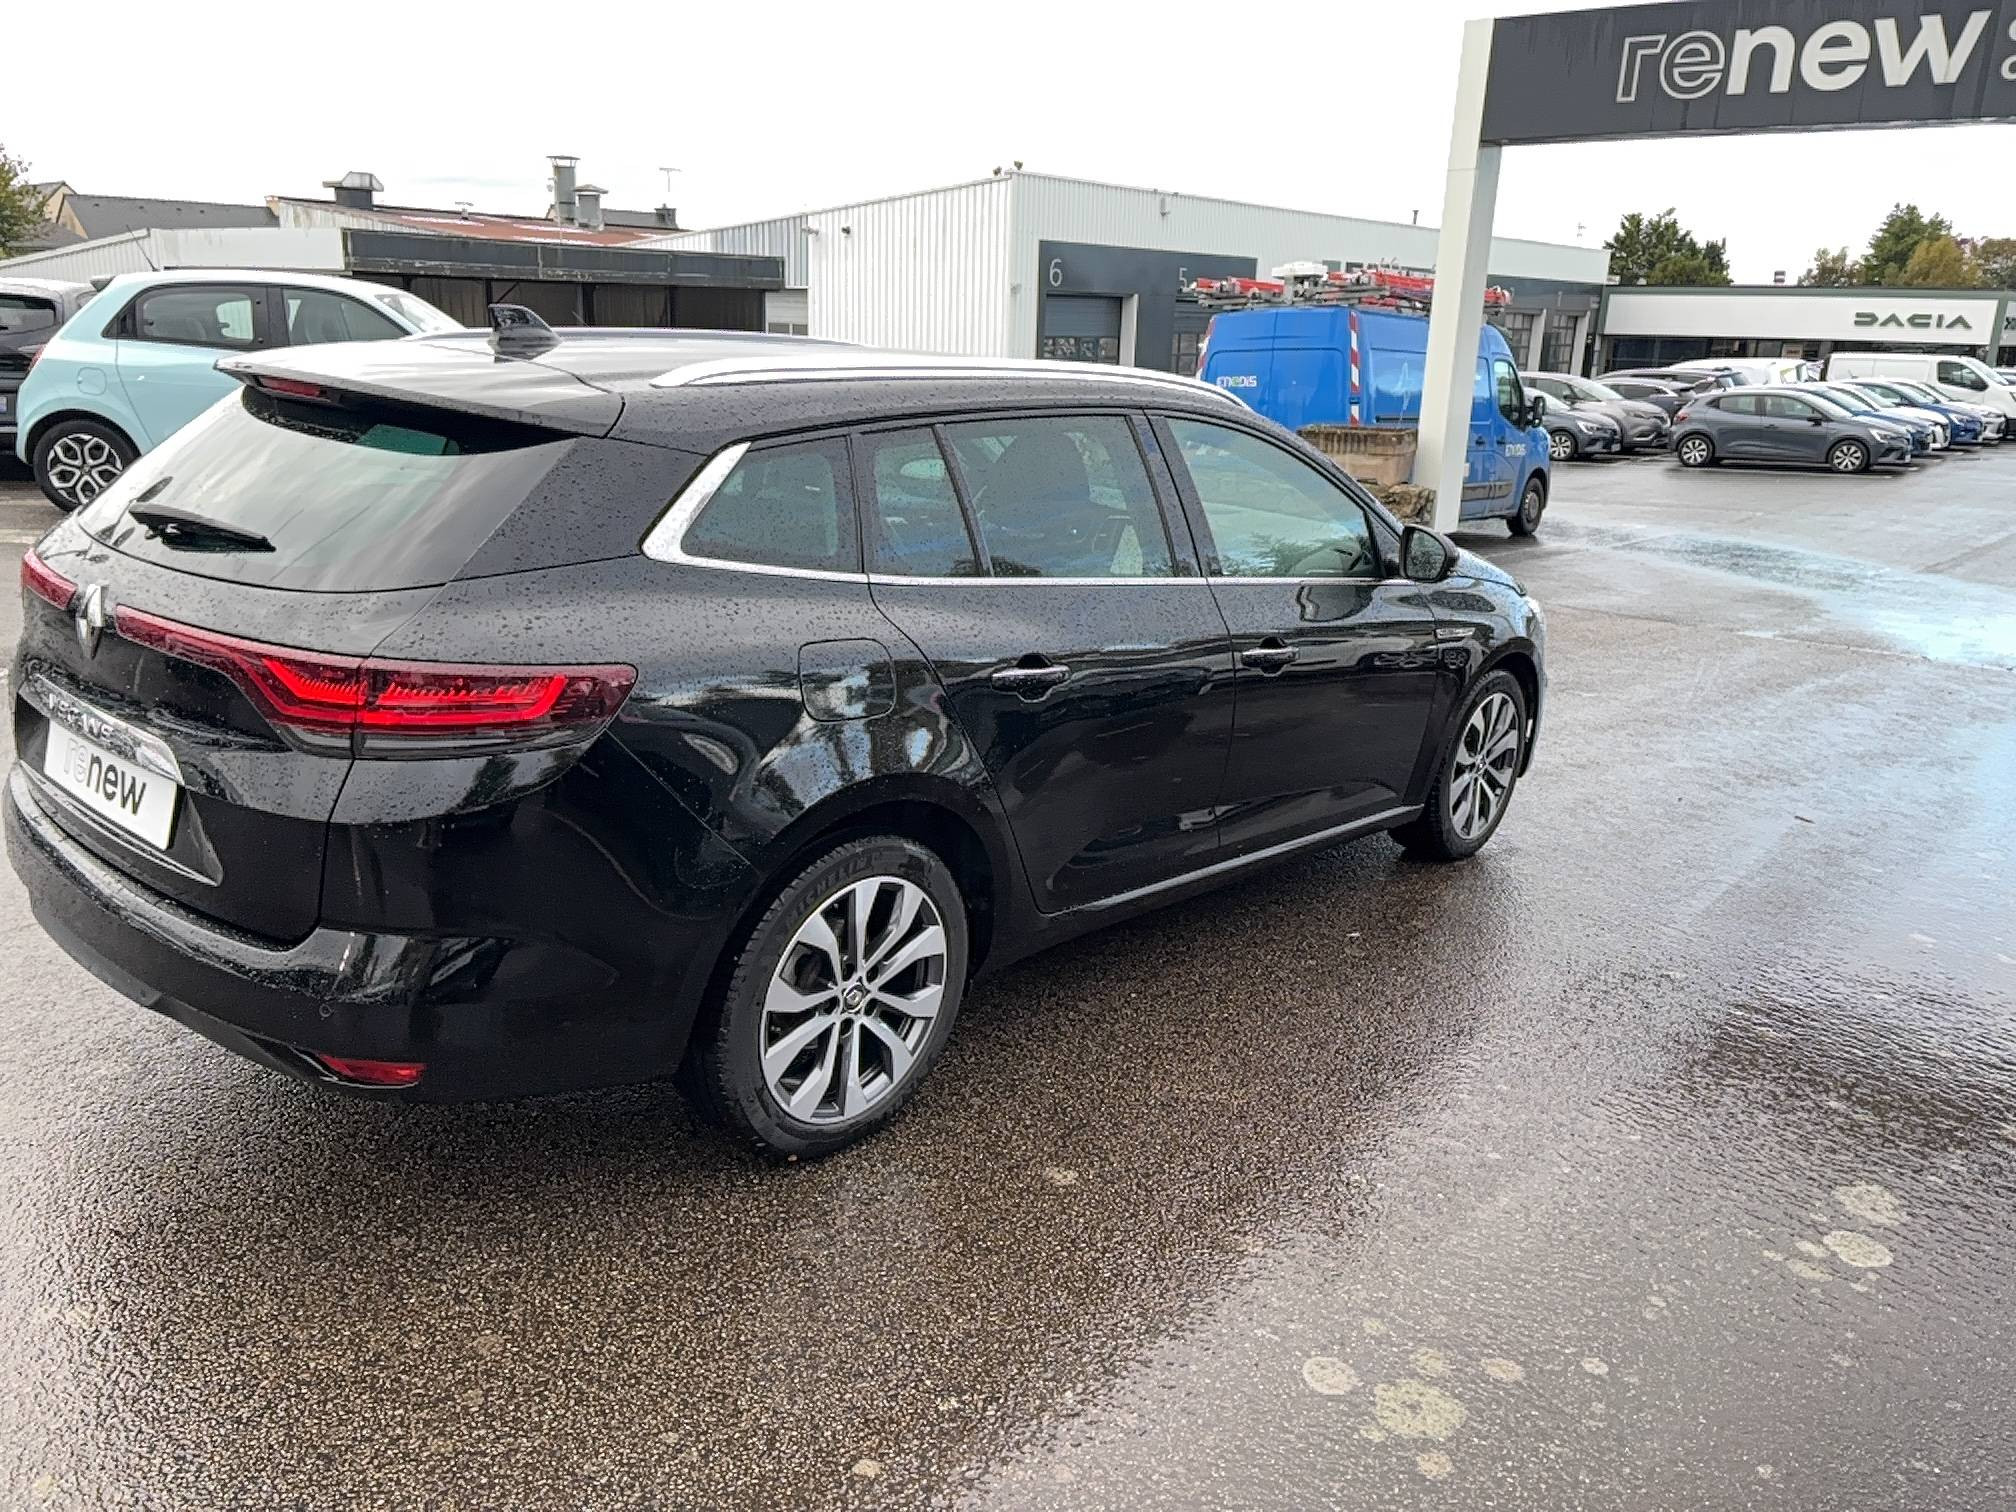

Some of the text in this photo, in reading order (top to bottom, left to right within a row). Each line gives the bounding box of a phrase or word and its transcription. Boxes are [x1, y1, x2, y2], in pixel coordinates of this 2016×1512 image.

[1616, 10, 1992, 102] renew
[1050, 258, 1062, 287] 6
[1179, 267, 1188, 289] 5
[1854, 312, 1973, 329] DACIA
[64, 738, 146, 815] renew
